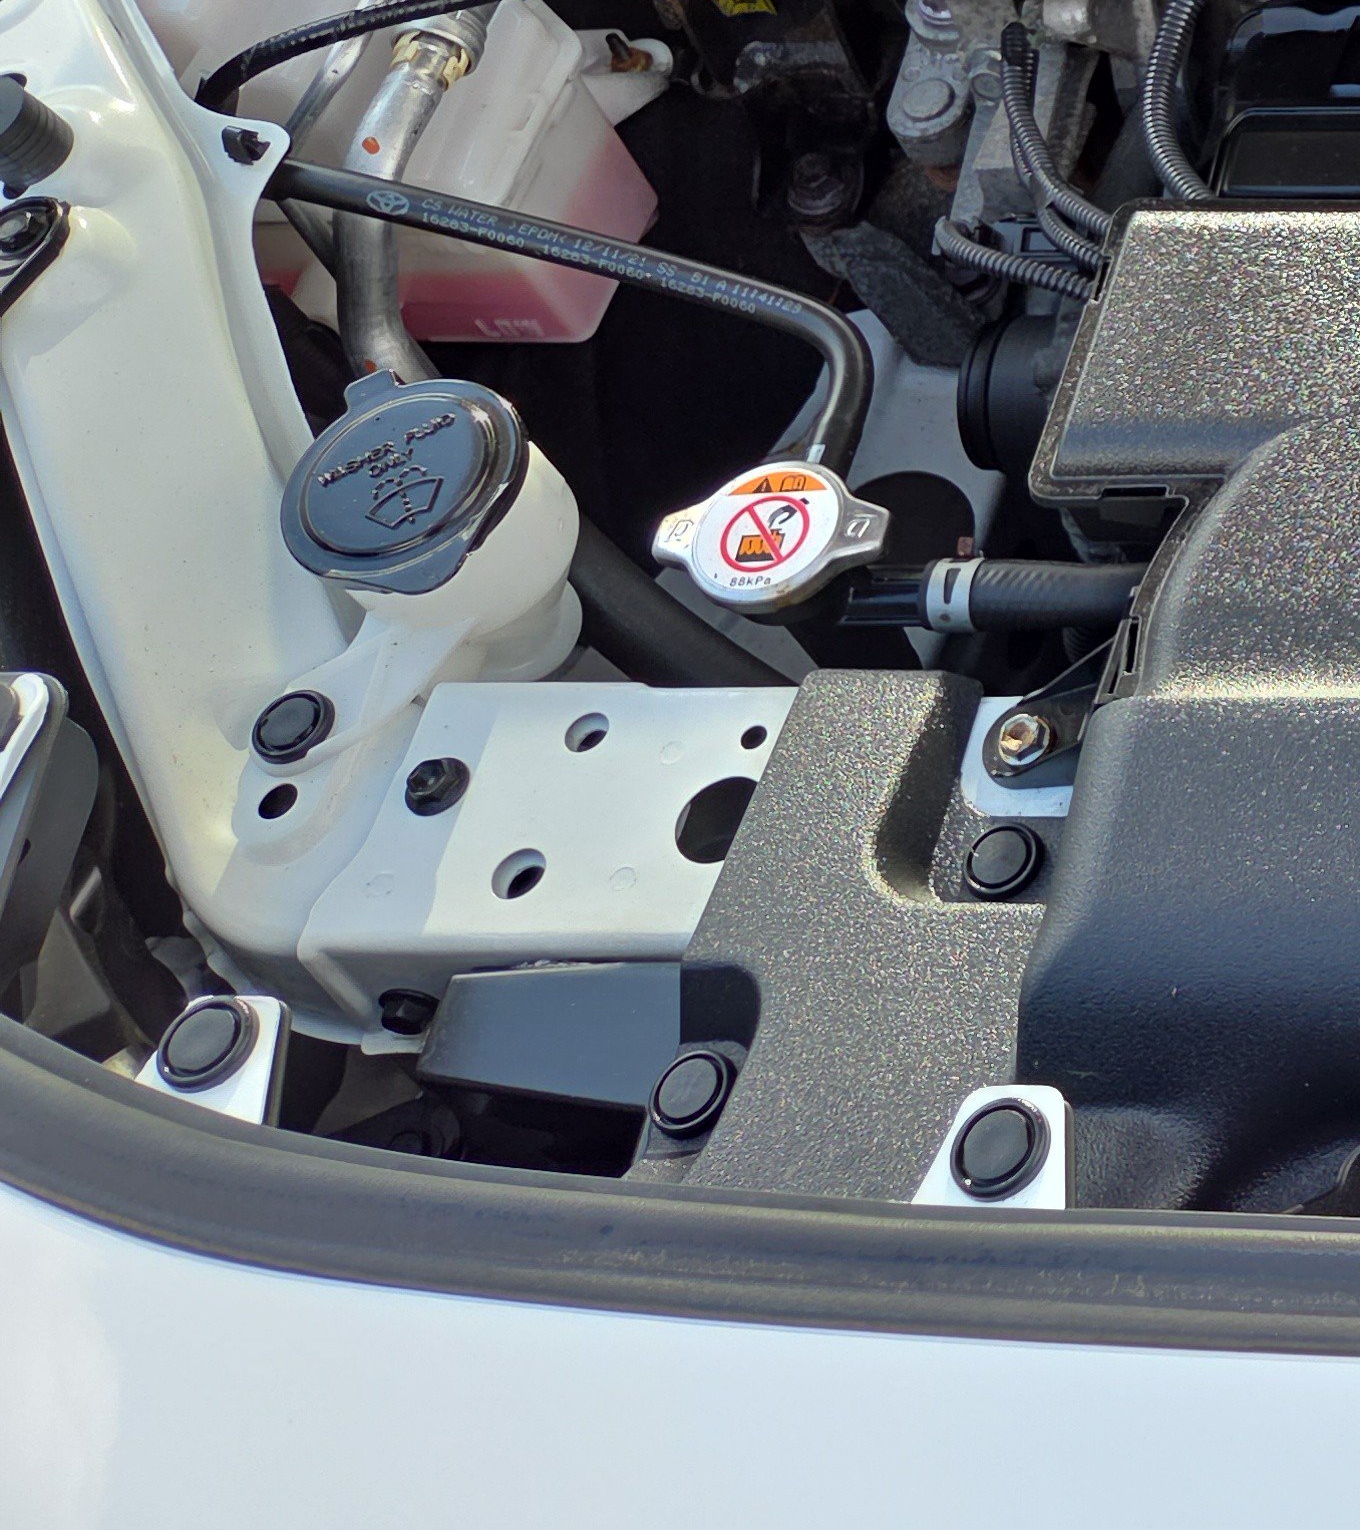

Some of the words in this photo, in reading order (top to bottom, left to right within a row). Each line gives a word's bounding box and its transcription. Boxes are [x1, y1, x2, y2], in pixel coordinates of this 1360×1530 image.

[421, 198, 442, 211] CS
[447, 204, 499, 227] WATER
[318, 441, 395, 488] WASHER
[404, 411, 456, 445] FLUID
[368, 448, 414, 479] ONLY
[729, 575, 772, 588] 88kPa
